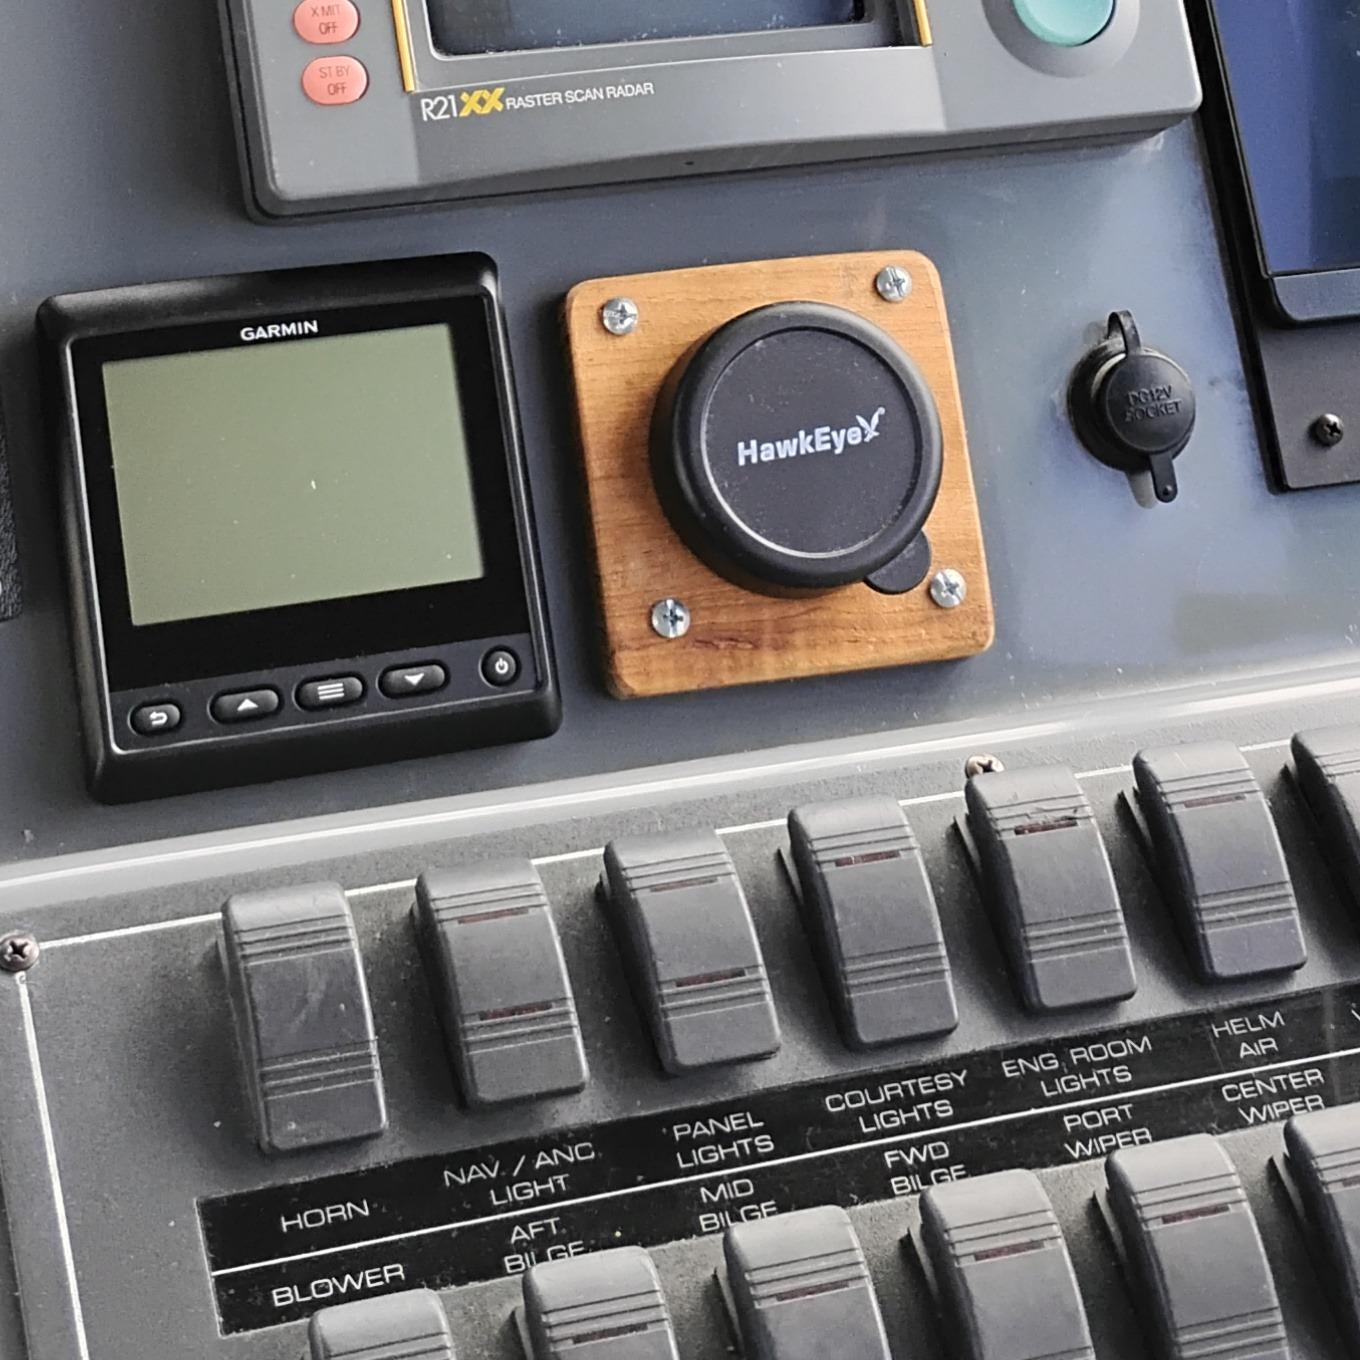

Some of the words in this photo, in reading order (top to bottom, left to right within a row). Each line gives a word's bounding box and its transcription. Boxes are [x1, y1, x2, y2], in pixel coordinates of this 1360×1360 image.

[318, 22, 339, 36] OFF
[327, 82, 347, 96] OFF
[506, 91, 563, 112] RASTER
[565, 87, 604, 105] SCAN
[606, 83, 654, 101] RADAR
[240, 320, 319, 342] GARMIN
[1125, 399, 1182, 422] SOCKET
[737, 423, 862, 466] HawkEye
[1211, 1011, 1286, 1039] HELM
[1002, 1051, 1066, 1078] ENG.
[1071, 1036, 1153, 1063] ROOM
[1239, 1038, 1279, 1059] AIR
[825, 1070, 969, 1114] COURTESY
[1040, 1066, 1132, 1098] LIGHTS
[1221, 1069, 1325, 1102] CENTER
[858, 1101, 954, 1134] LIGHTS
[1063, 1104, 1134, 1133] PORT
[1239, 1095, 1326, 1125] WIPER
[673, 1111, 764, 1142] PANEL
[676, 1135, 775, 1170] LIGHTS
[884, 1142, 949, 1169] FWD
[1064, 1128, 1153, 1160] WIPER
[490, 1174, 570, 1206] LIGHT
[700, 1178, 755, 1203] MID
[280, 1199, 371, 1233] HORN
[510, 1217, 562, 1242] AFT
[698, 1202, 778, 1233] BILGE
[271, 1263, 406, 1307] BLOWER
